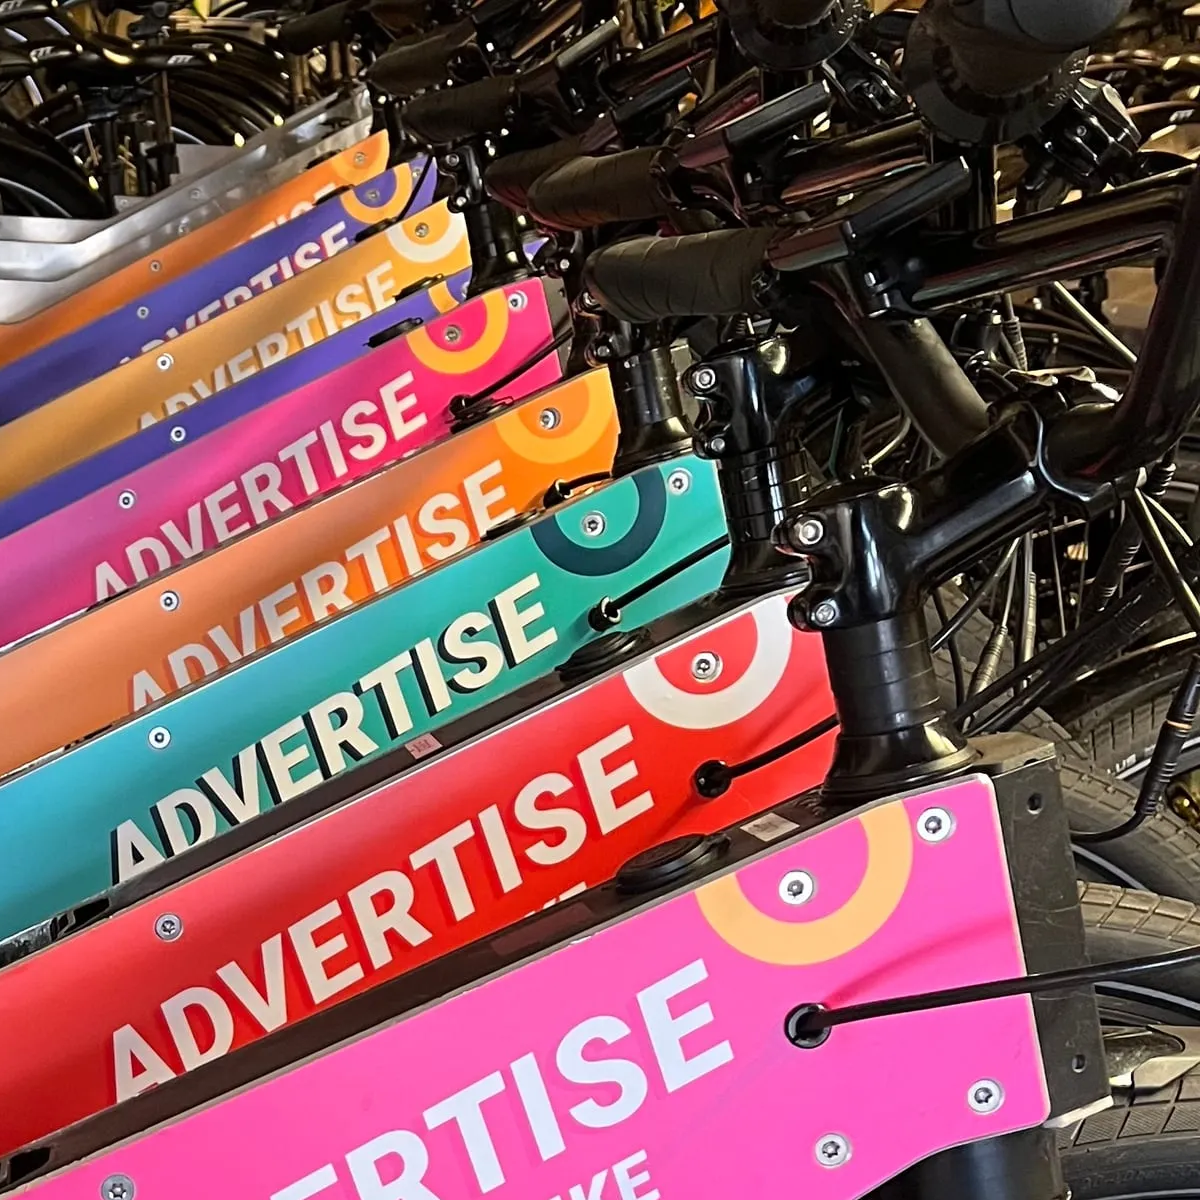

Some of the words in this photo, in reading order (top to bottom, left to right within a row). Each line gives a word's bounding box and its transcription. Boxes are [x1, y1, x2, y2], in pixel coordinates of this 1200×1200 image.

[95, 370, 429, 601] ADVERTISE
[113, 572, 558, 885] ADVERTISE
[113, 725, 654, 1104] ADVERTISE
